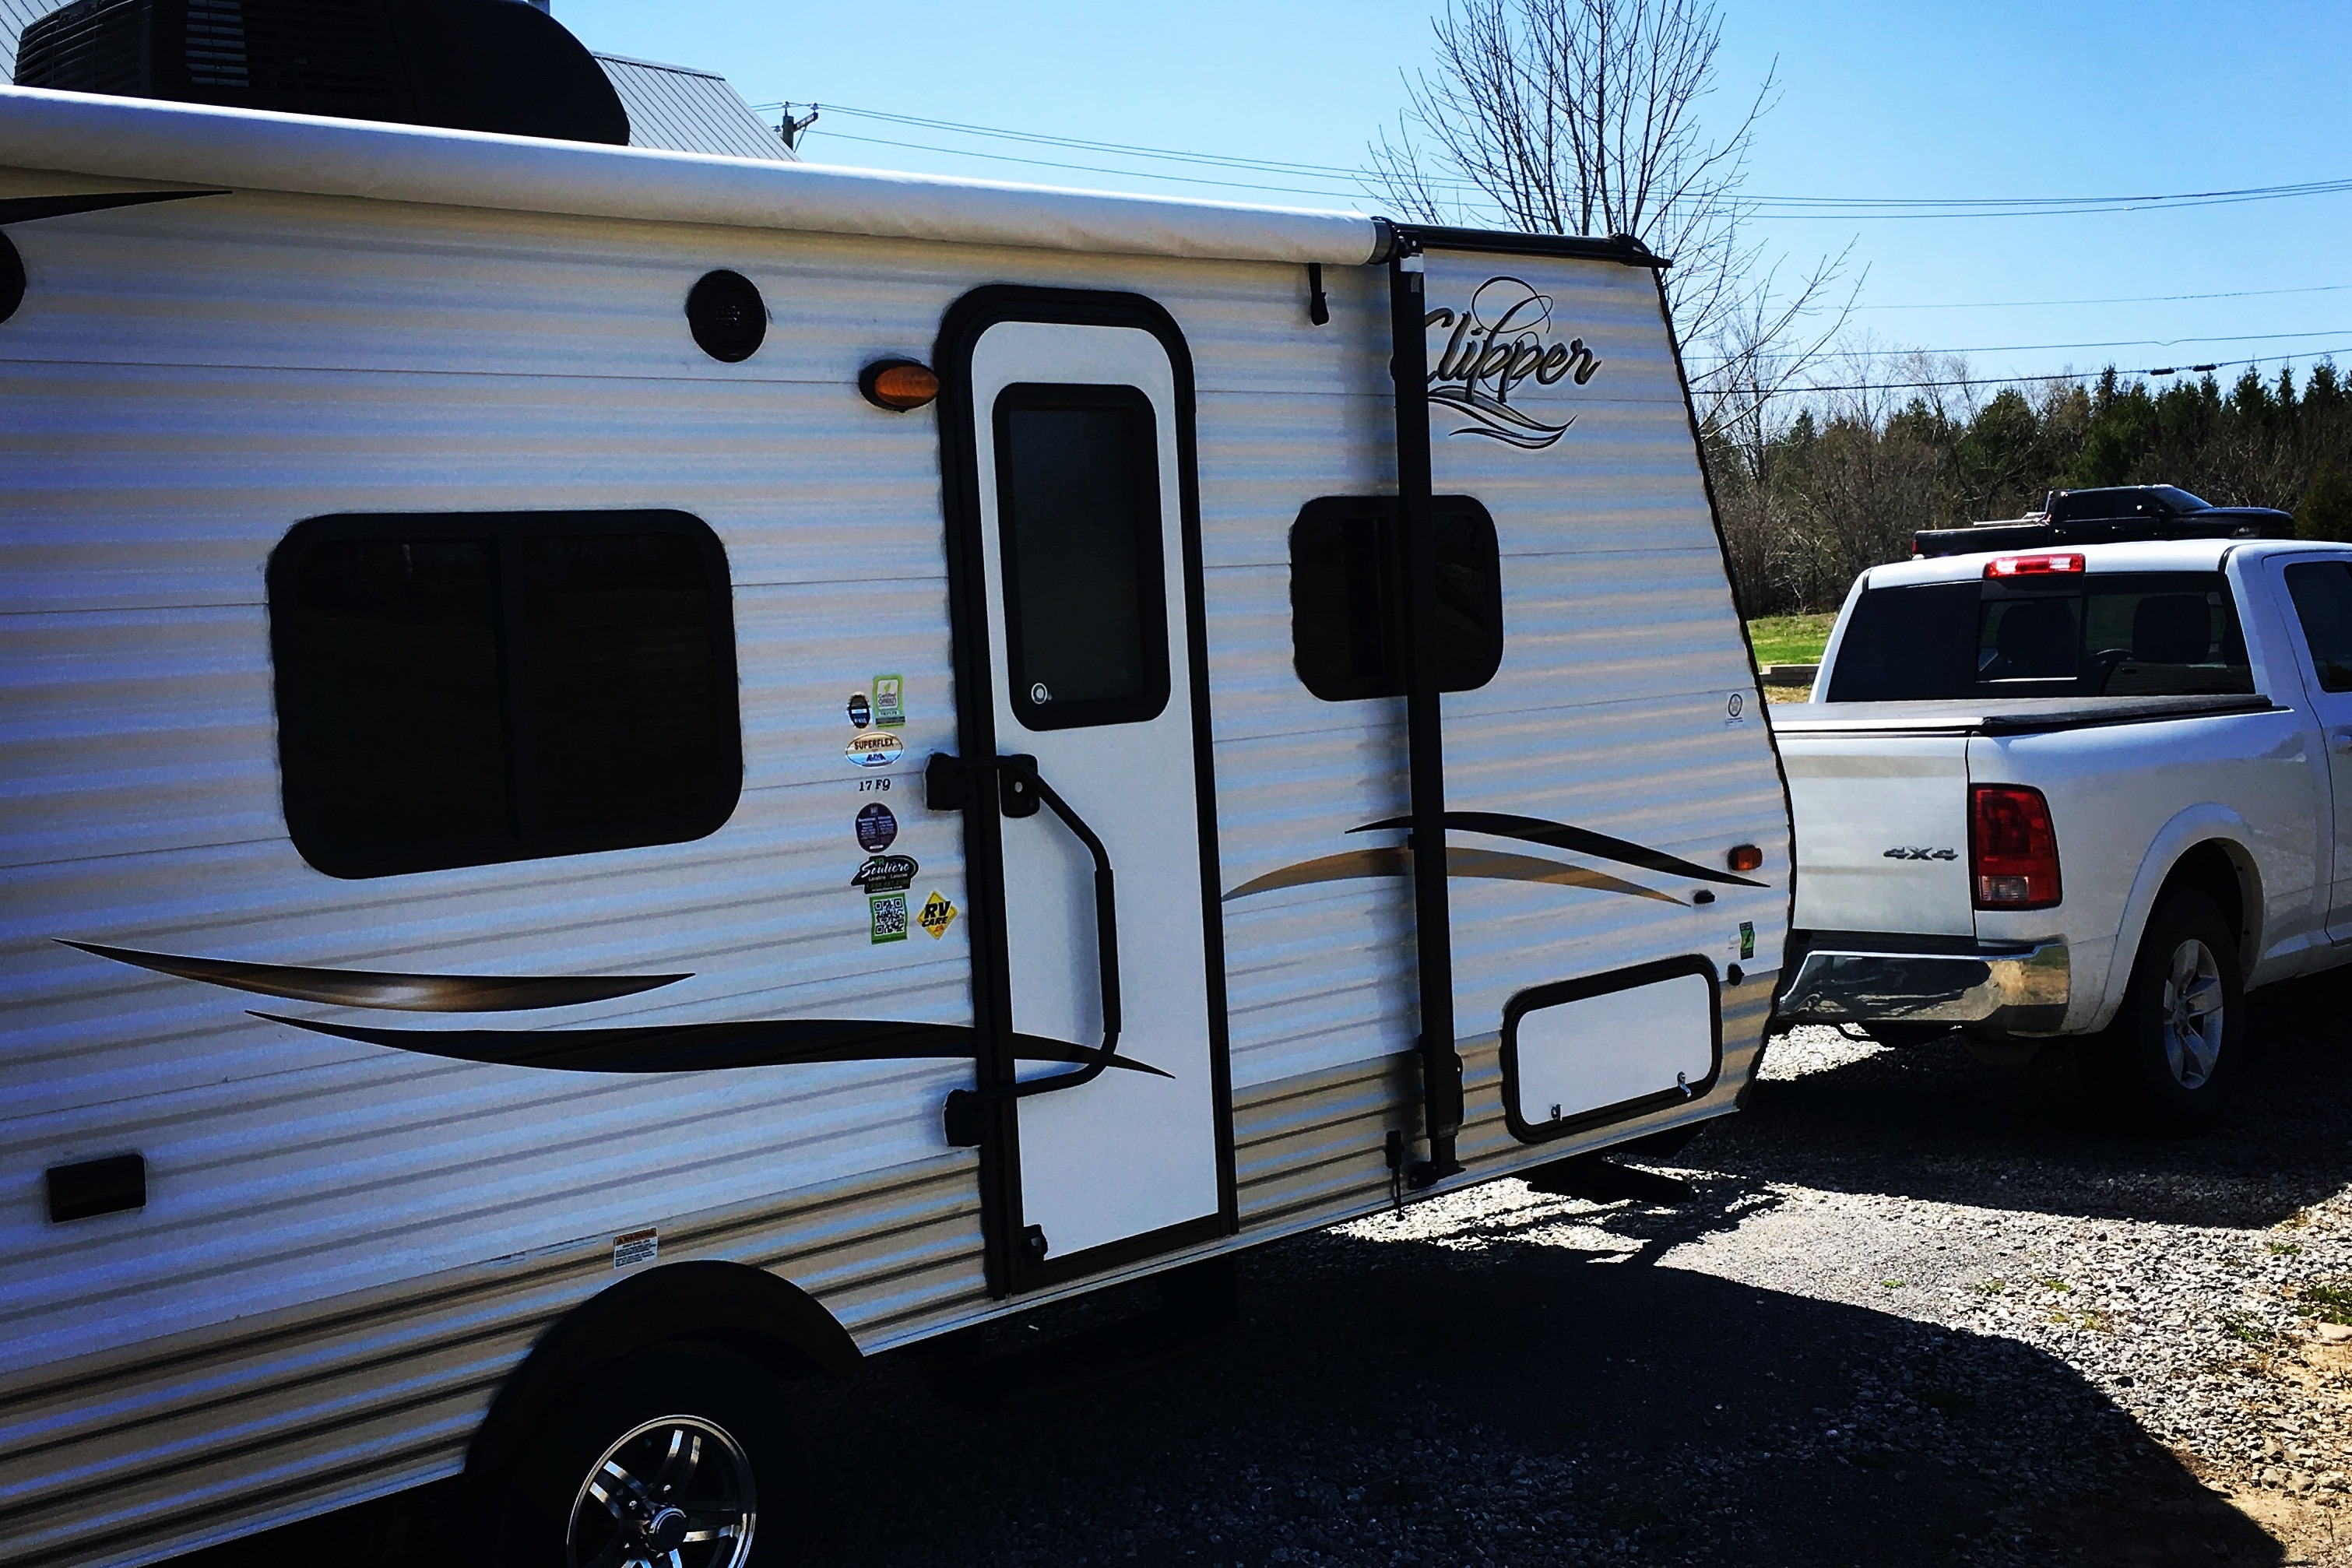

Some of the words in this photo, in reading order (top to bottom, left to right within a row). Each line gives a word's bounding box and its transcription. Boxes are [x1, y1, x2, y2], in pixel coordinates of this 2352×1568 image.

[1425, 277, 1602, 403] Clipper
[854, 738, 894, 751] SUPERFLEX
[859, 780, 873, 792] 17
[924, 901, 951, 919] RV
[922, 916, 948, 927] CARE
